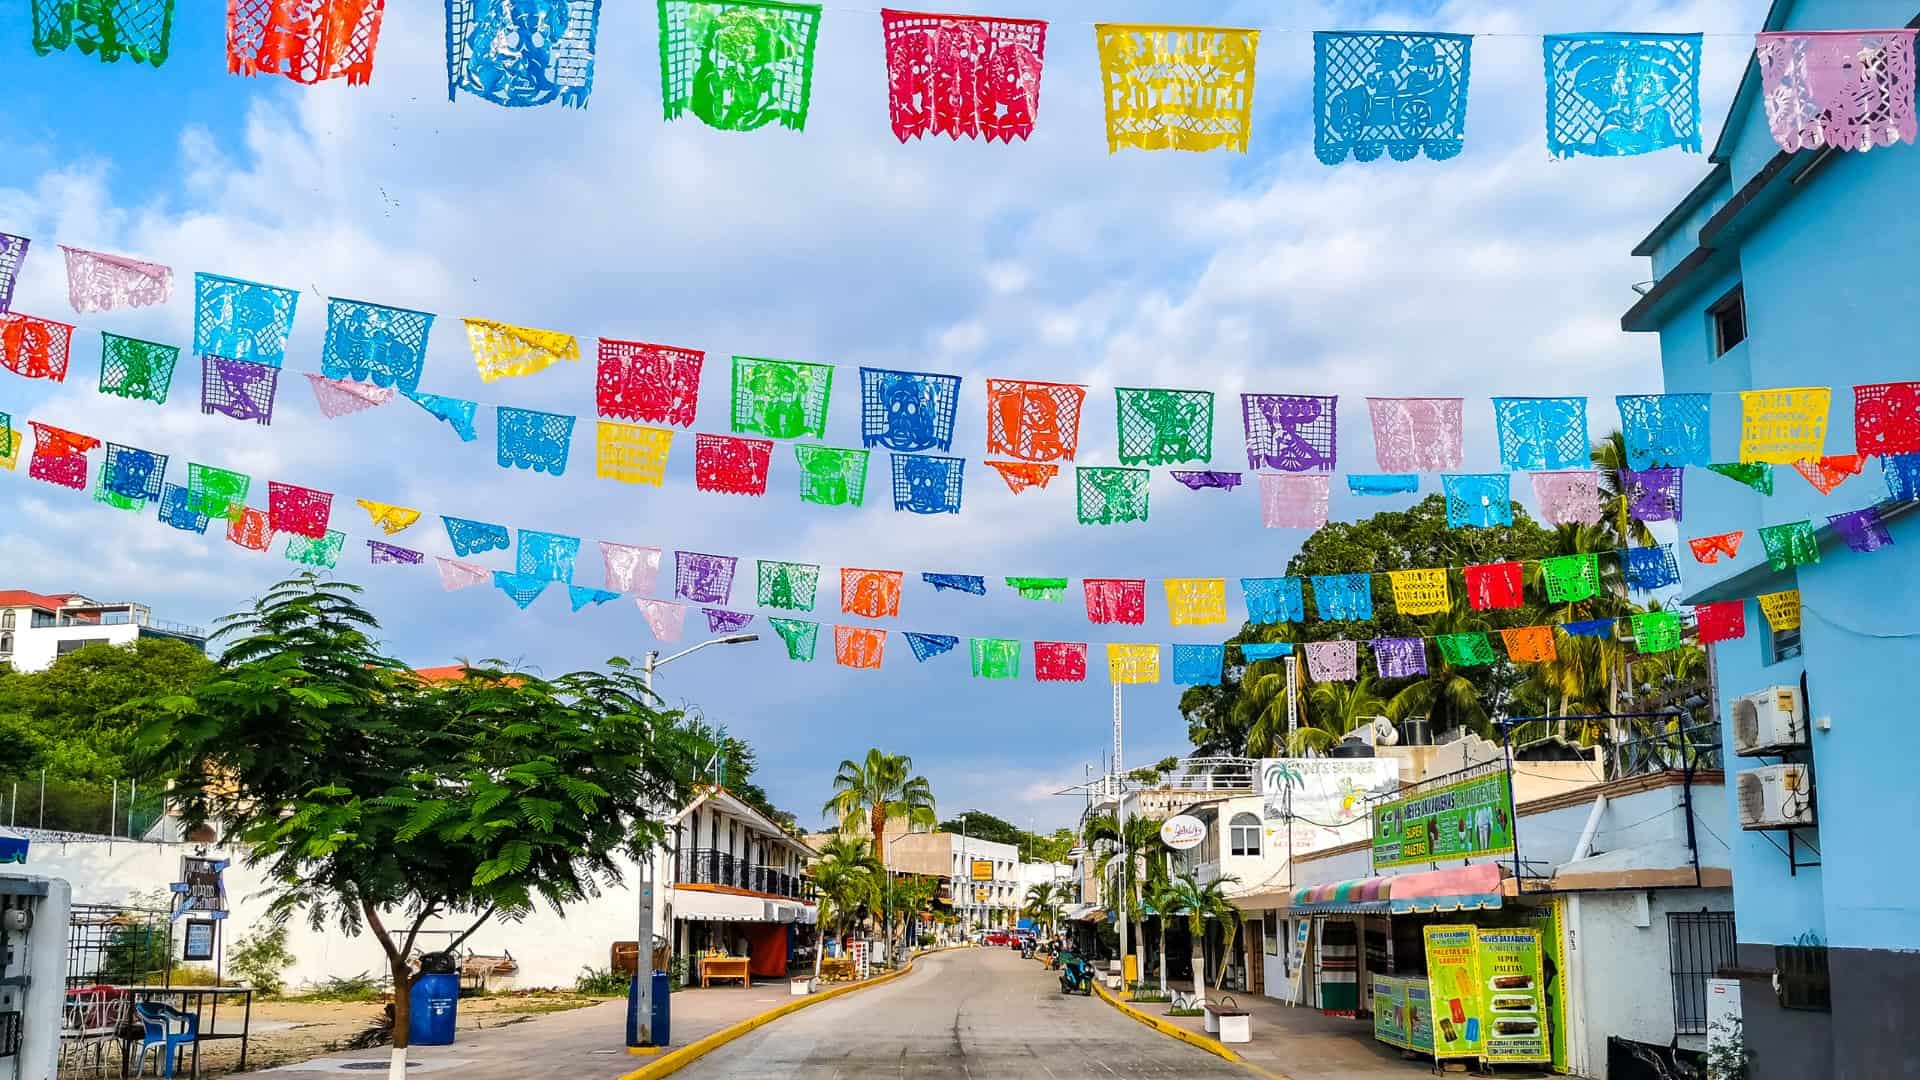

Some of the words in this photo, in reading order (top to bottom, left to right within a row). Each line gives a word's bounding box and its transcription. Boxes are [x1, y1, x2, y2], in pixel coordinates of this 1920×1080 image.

[1406, 823, 1424, 840] SUPER
[1404, 842, 1426, 857] PALETAS
[1494, 964, 1523, 972] PALETAS
